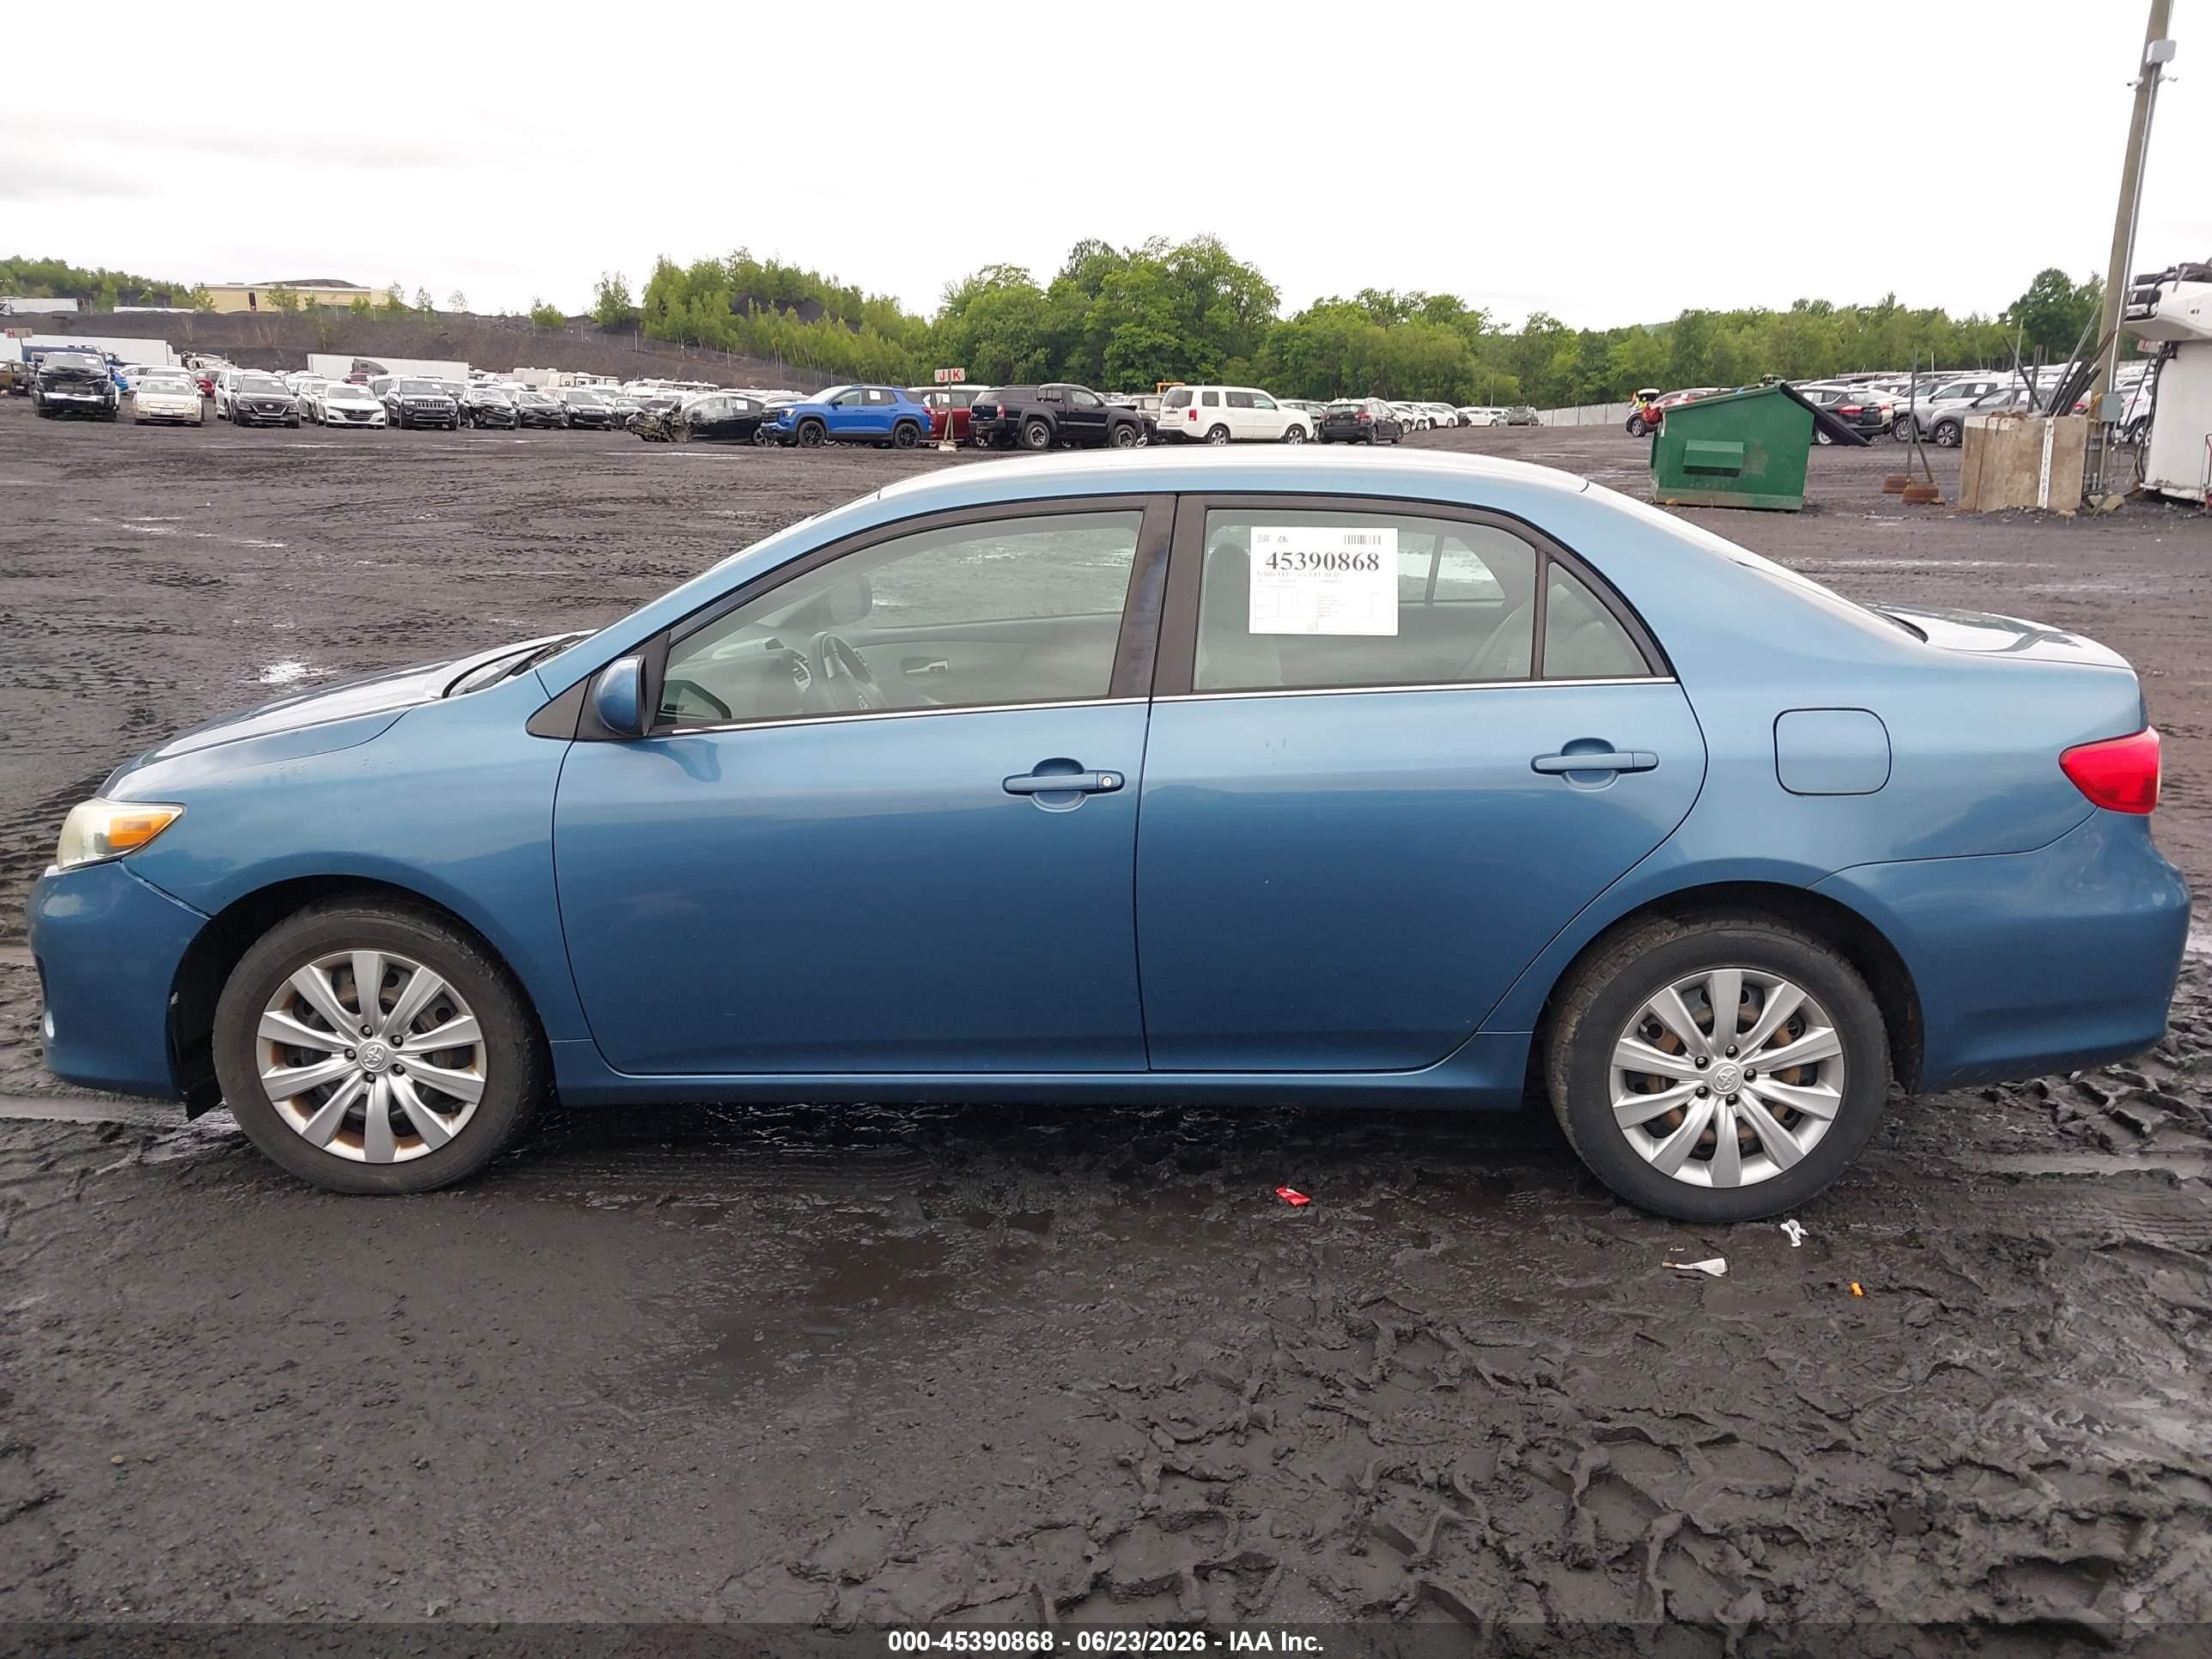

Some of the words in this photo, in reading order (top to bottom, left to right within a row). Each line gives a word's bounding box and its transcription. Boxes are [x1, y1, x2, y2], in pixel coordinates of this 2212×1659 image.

[939, 370, 946, 381] J
[952, 369, 961, 380] K
[1266, 551, 1379, 571] 45390868
